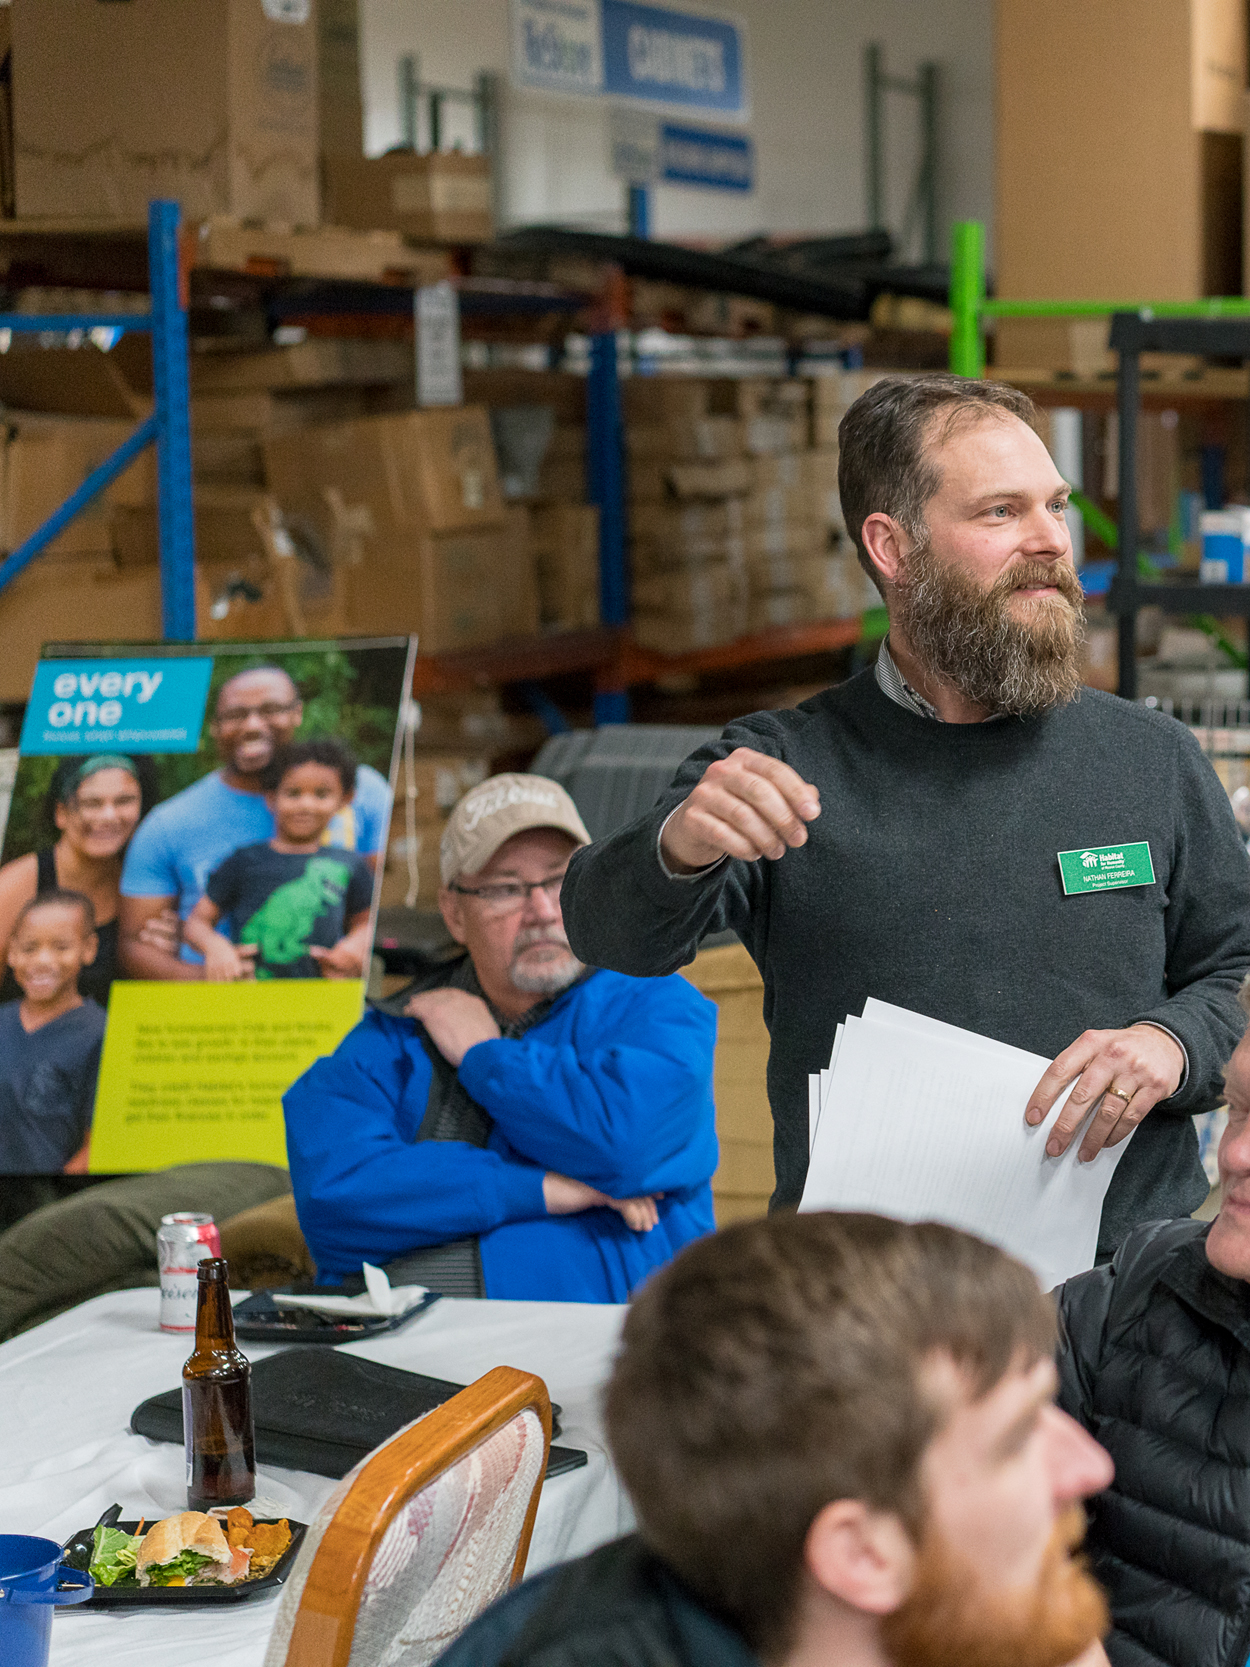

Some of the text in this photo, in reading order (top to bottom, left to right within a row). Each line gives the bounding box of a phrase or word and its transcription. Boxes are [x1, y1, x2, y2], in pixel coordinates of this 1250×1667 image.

[53, 671, 164, 704] every
[48, 700, 123, 728] one
[1099, 852, 1124, 861] Habitat
[1083, 870, 1135, 882] NATHAN FERREIRA
